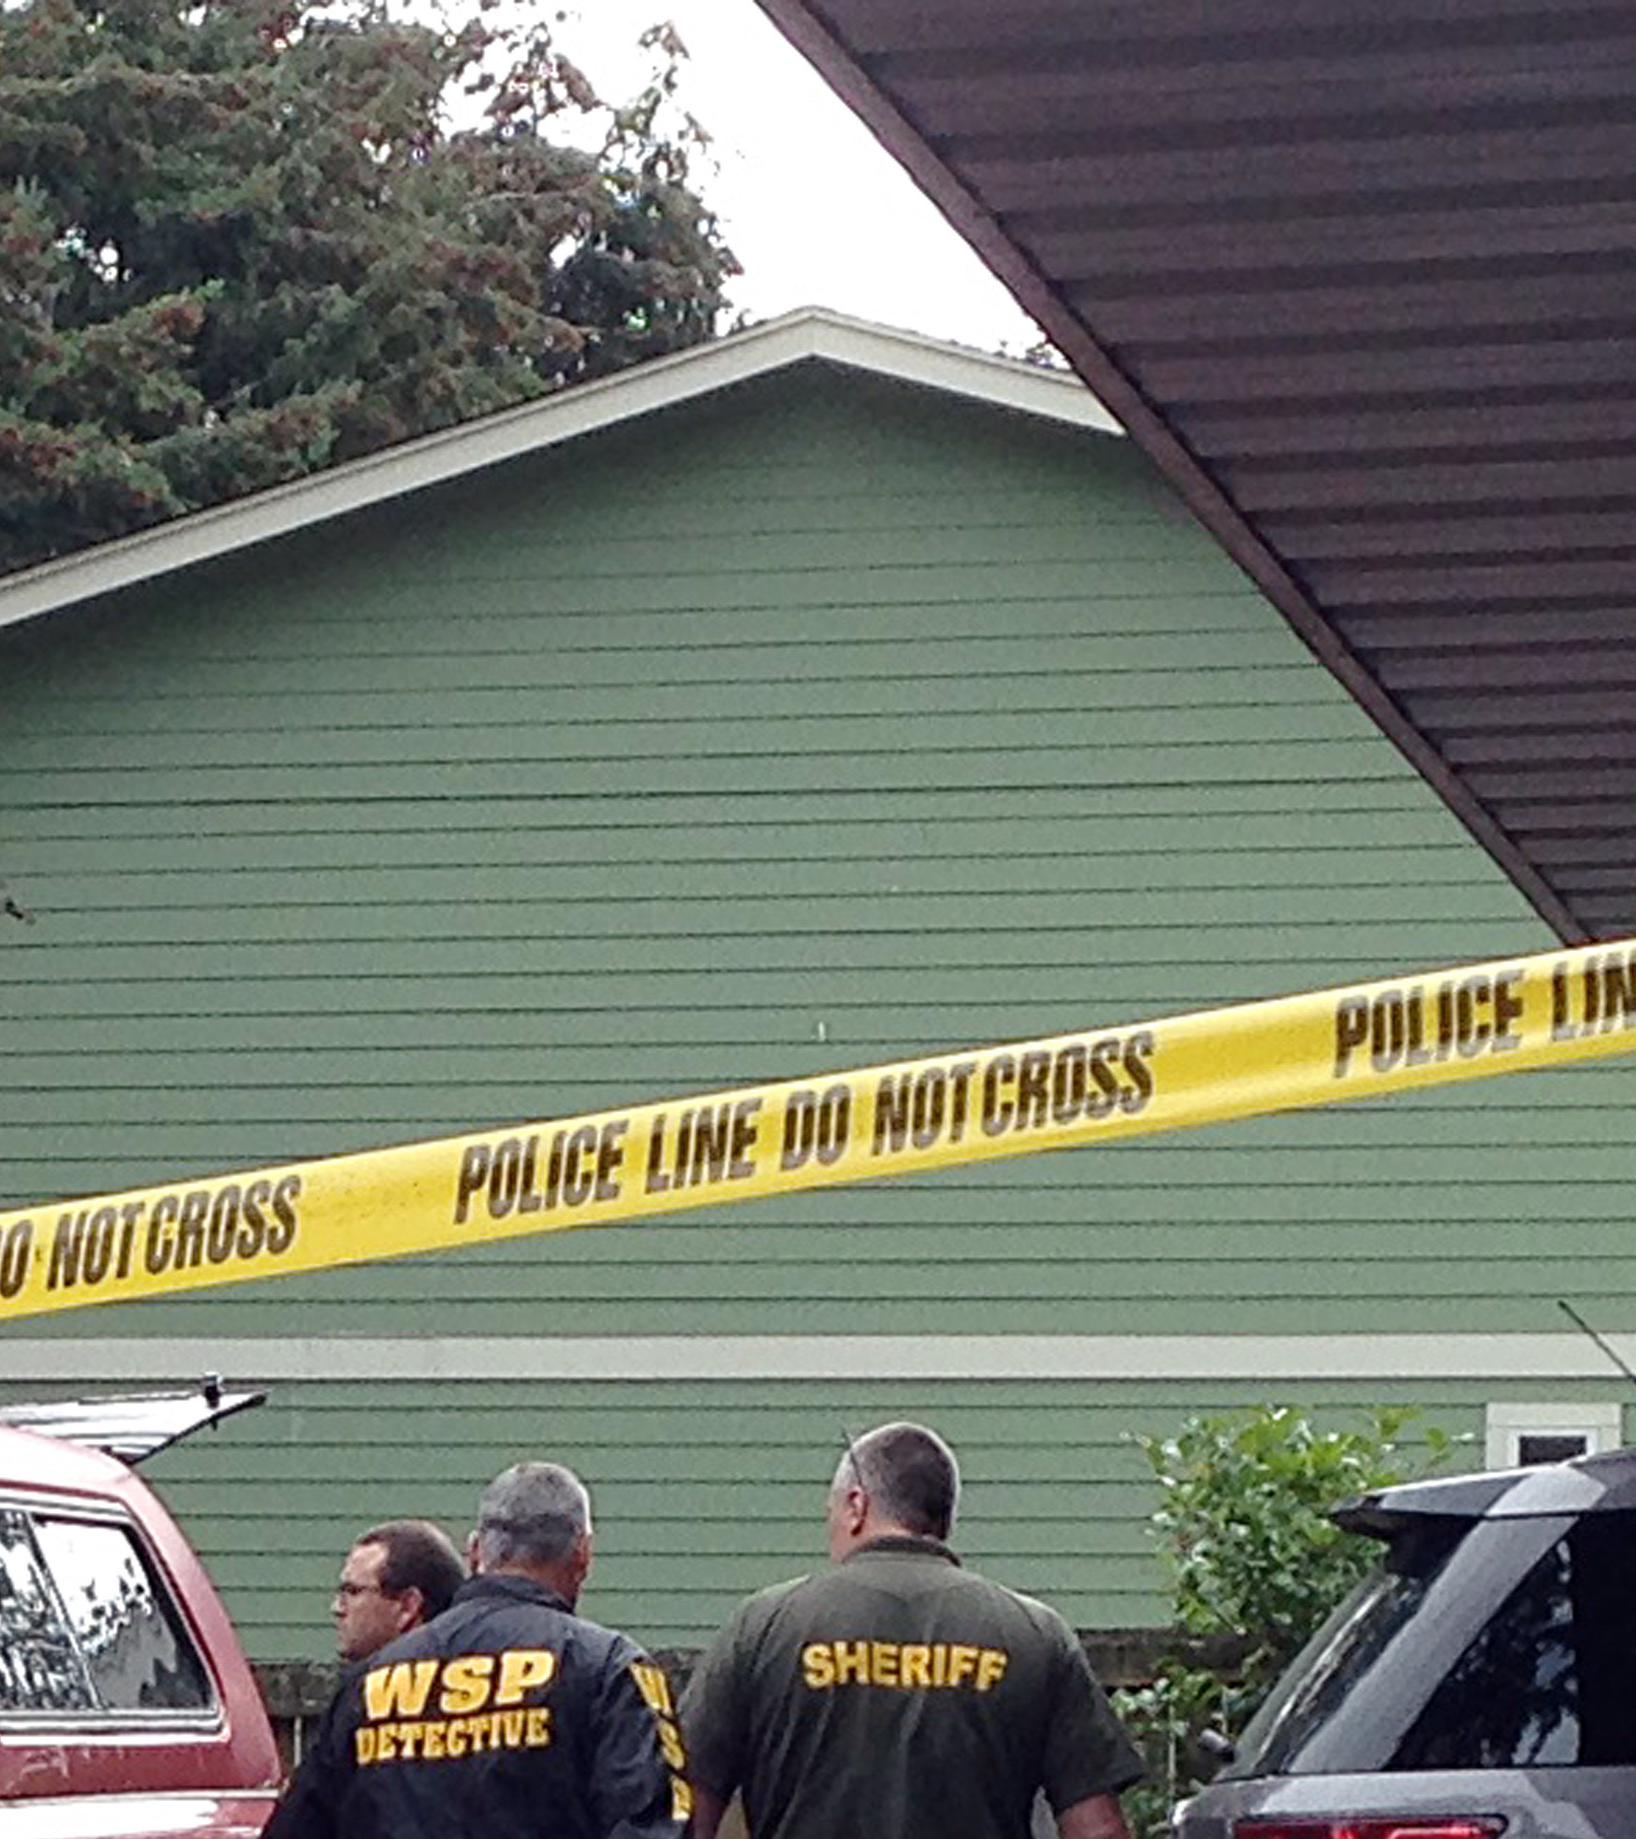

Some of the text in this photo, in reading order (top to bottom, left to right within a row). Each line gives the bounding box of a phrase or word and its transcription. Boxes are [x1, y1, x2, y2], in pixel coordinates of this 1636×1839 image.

[1333, 969, 1526, 1079] POLICE
[453, 1030, 1155, 1224] POLICE LINE DO NOT CROSS
[46, 1202, 145, 1291] NOT
[144, 1174, 301, 1276] CROSS
[364, 1648, 557, 1720] WSP
[800, 1641, 1009, 1692] SHERIFF
[355, 1705, 551, 1767] DETECTIVE
